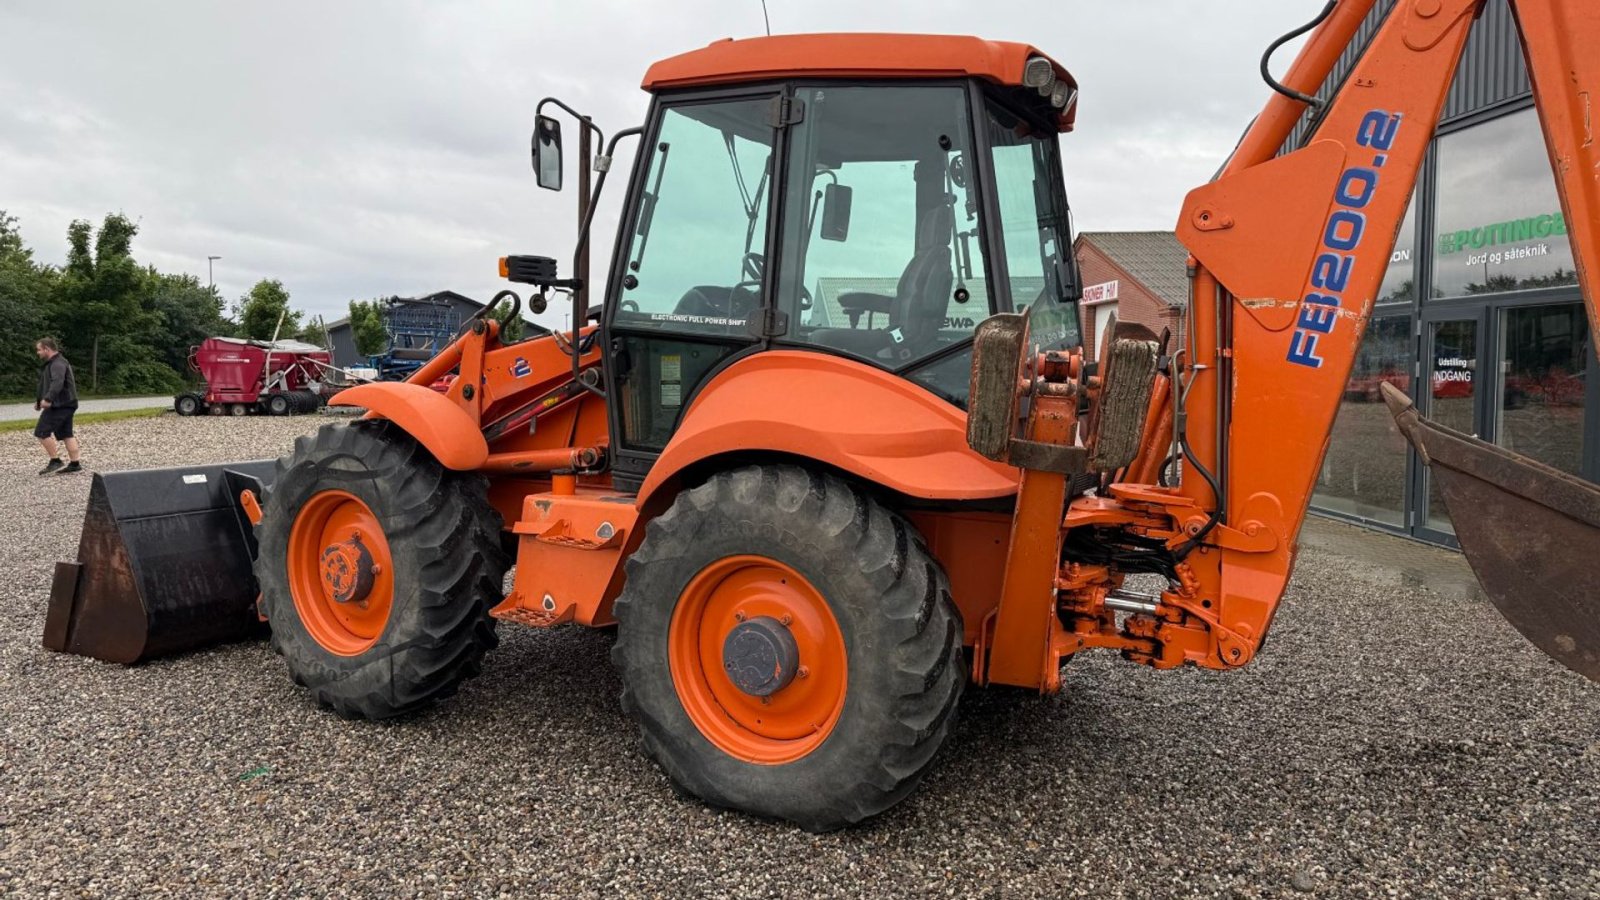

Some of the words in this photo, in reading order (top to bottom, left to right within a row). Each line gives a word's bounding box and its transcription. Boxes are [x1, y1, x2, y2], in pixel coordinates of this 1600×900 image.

[1287, 109, 1404, 368] FB200.2
[1390, 249, 1410, 262] ON
[1466, 252, 1487, 266] Jord
[1489, 252, 1502, 264] og
[1504, 243, 1547, 261] såteknik
[1081, 285, 1104, 303] SKINER
[651, 313, 687, 322] ELECTRONIC
[688, 315, 704, 324] FULL
[704, 317, 727, 325] POWER
[728, 318, 746, 326] SHIFT
[1438, 357, 1467, 368] Udstilling
[1433, 370, 1471, 382] INDGANG
